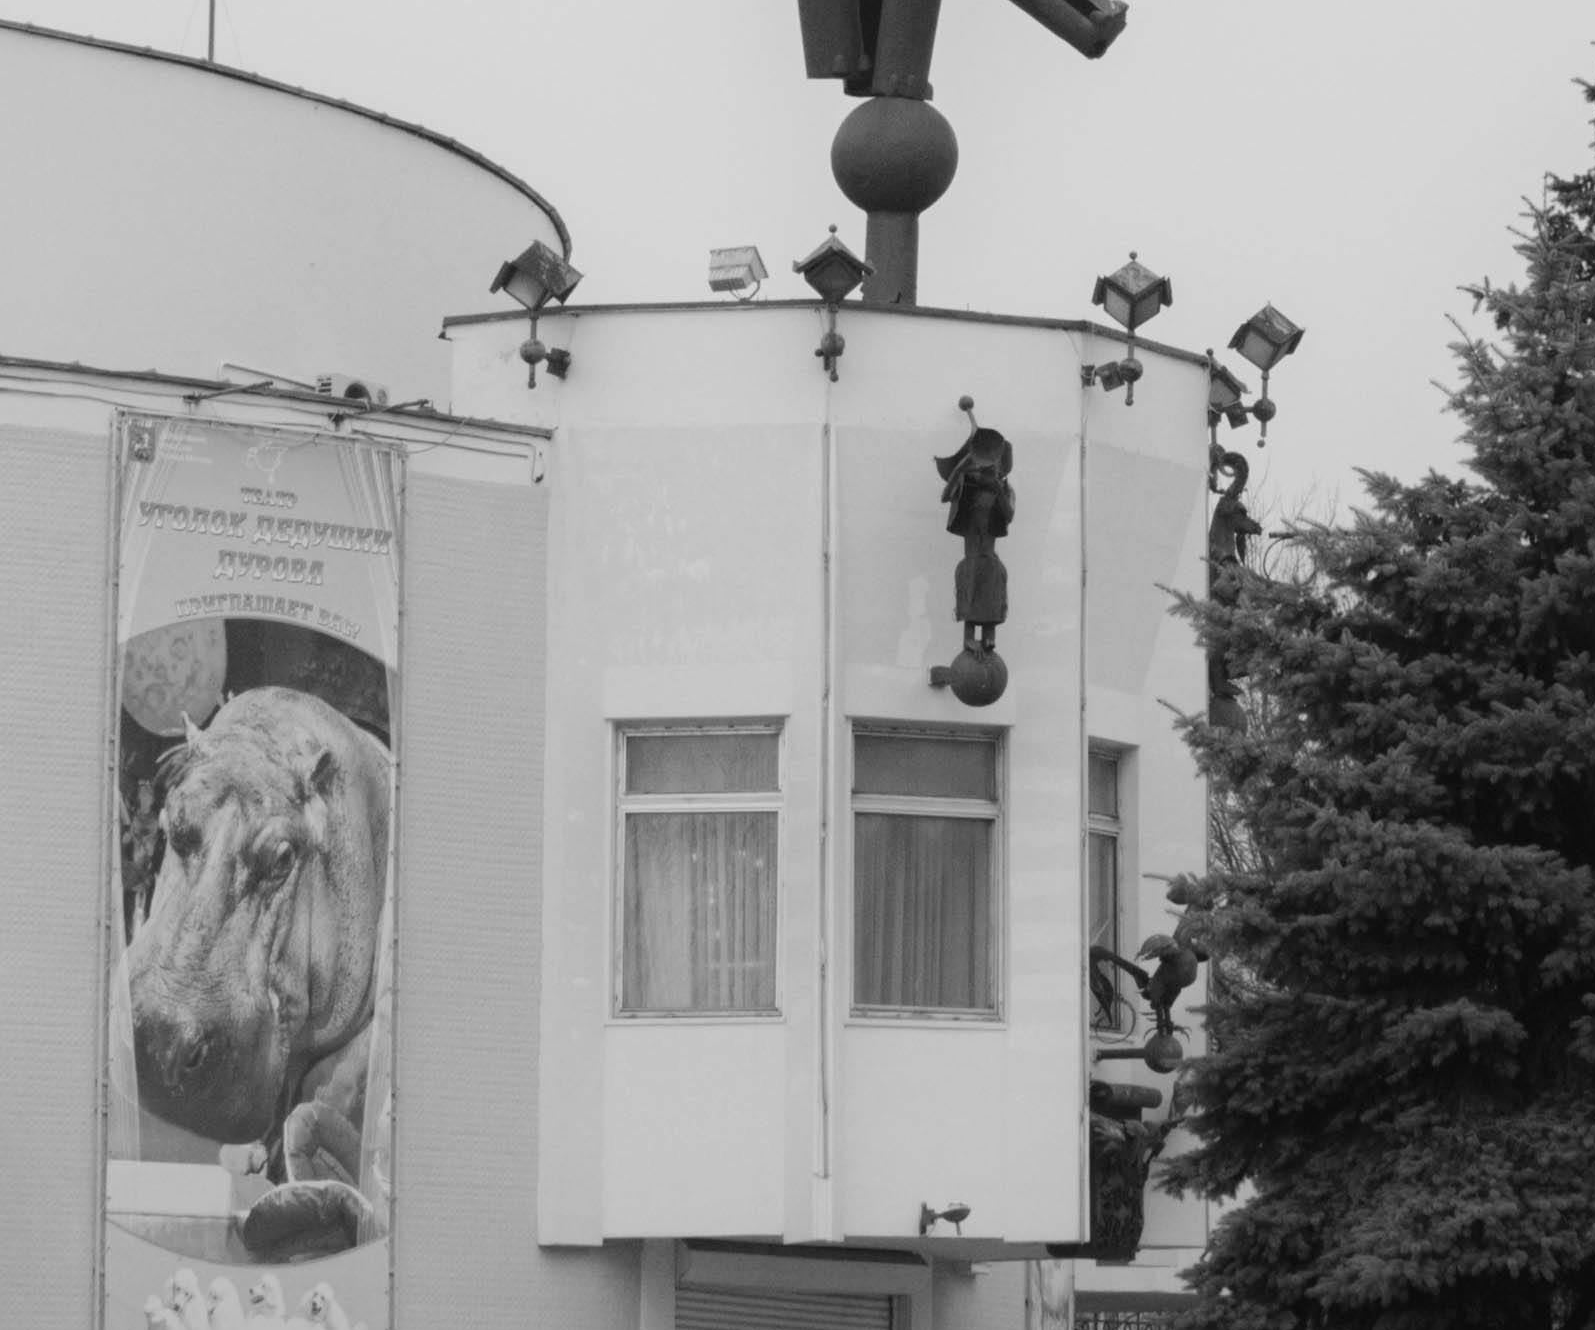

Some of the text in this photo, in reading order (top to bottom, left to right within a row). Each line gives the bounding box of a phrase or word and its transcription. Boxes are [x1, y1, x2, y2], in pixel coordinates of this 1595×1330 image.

[241, 487, 298, 509] ТЕАТР
[137, 501, 393, 555] УГОЛОК ДЕДУШКИ
[213, 549, 325, 585] ДУРОВА
